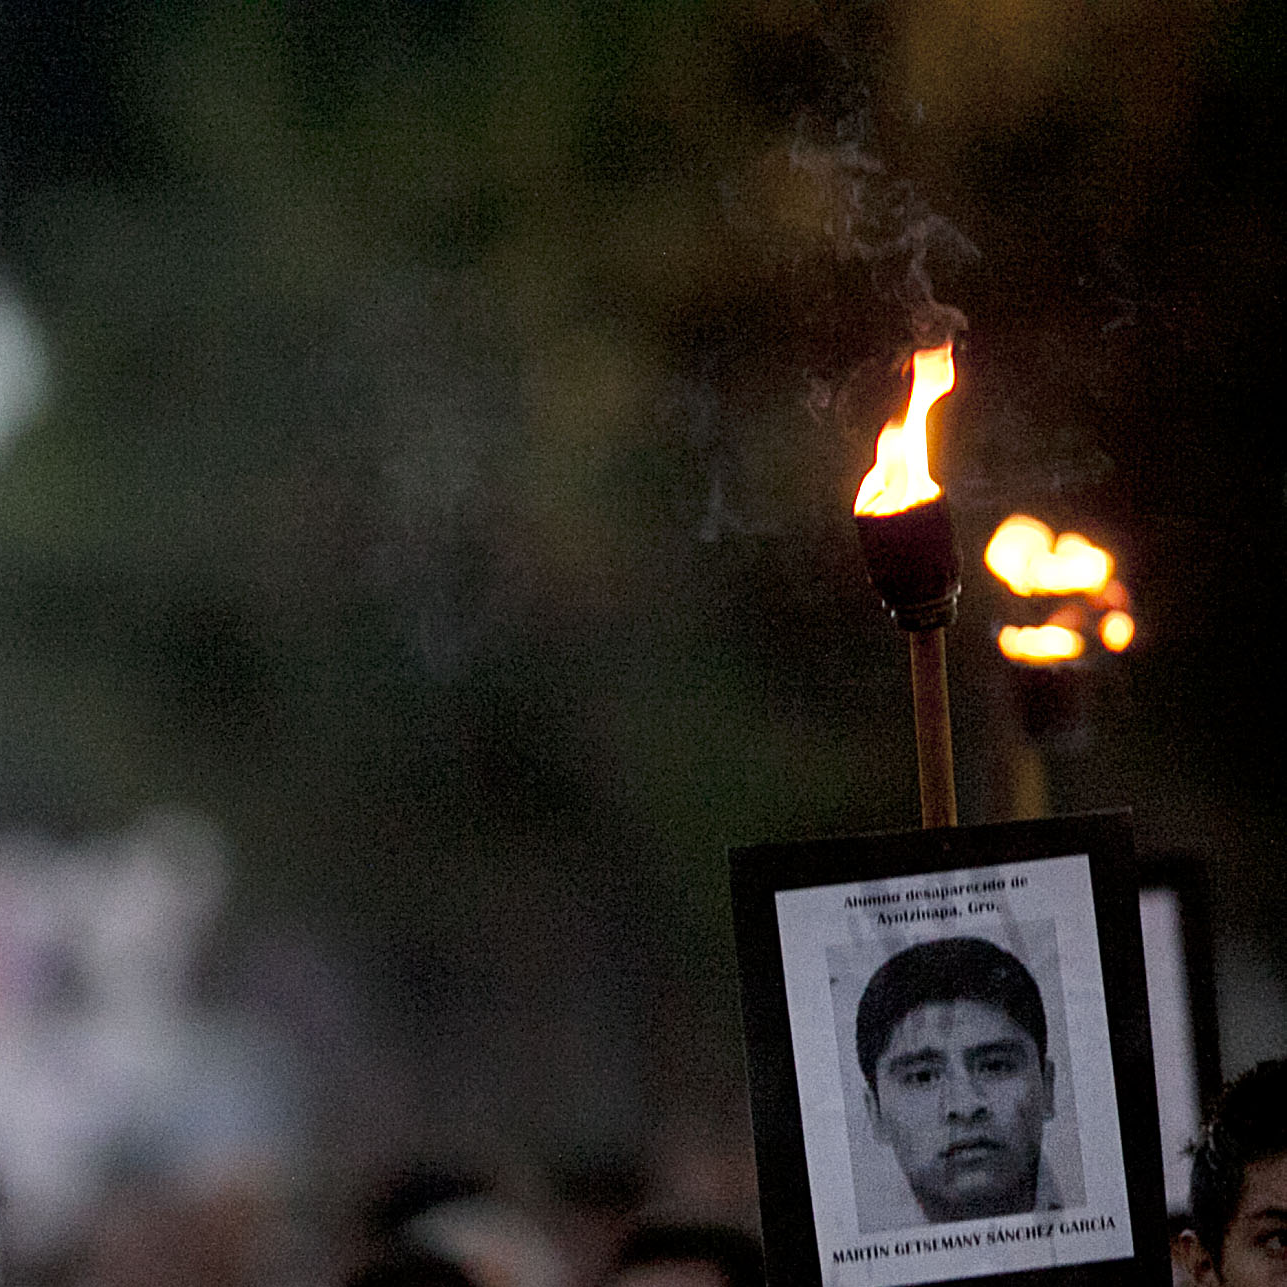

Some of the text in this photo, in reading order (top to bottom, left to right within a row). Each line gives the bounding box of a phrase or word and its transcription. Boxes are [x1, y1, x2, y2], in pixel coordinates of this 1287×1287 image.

[844, 874, 1028, 909] Alumno desaparecido de
[987, 1223, 1054, 1245] SÁNCHEZ
[1060, 1215, 1116, 1235] GARCÍA
